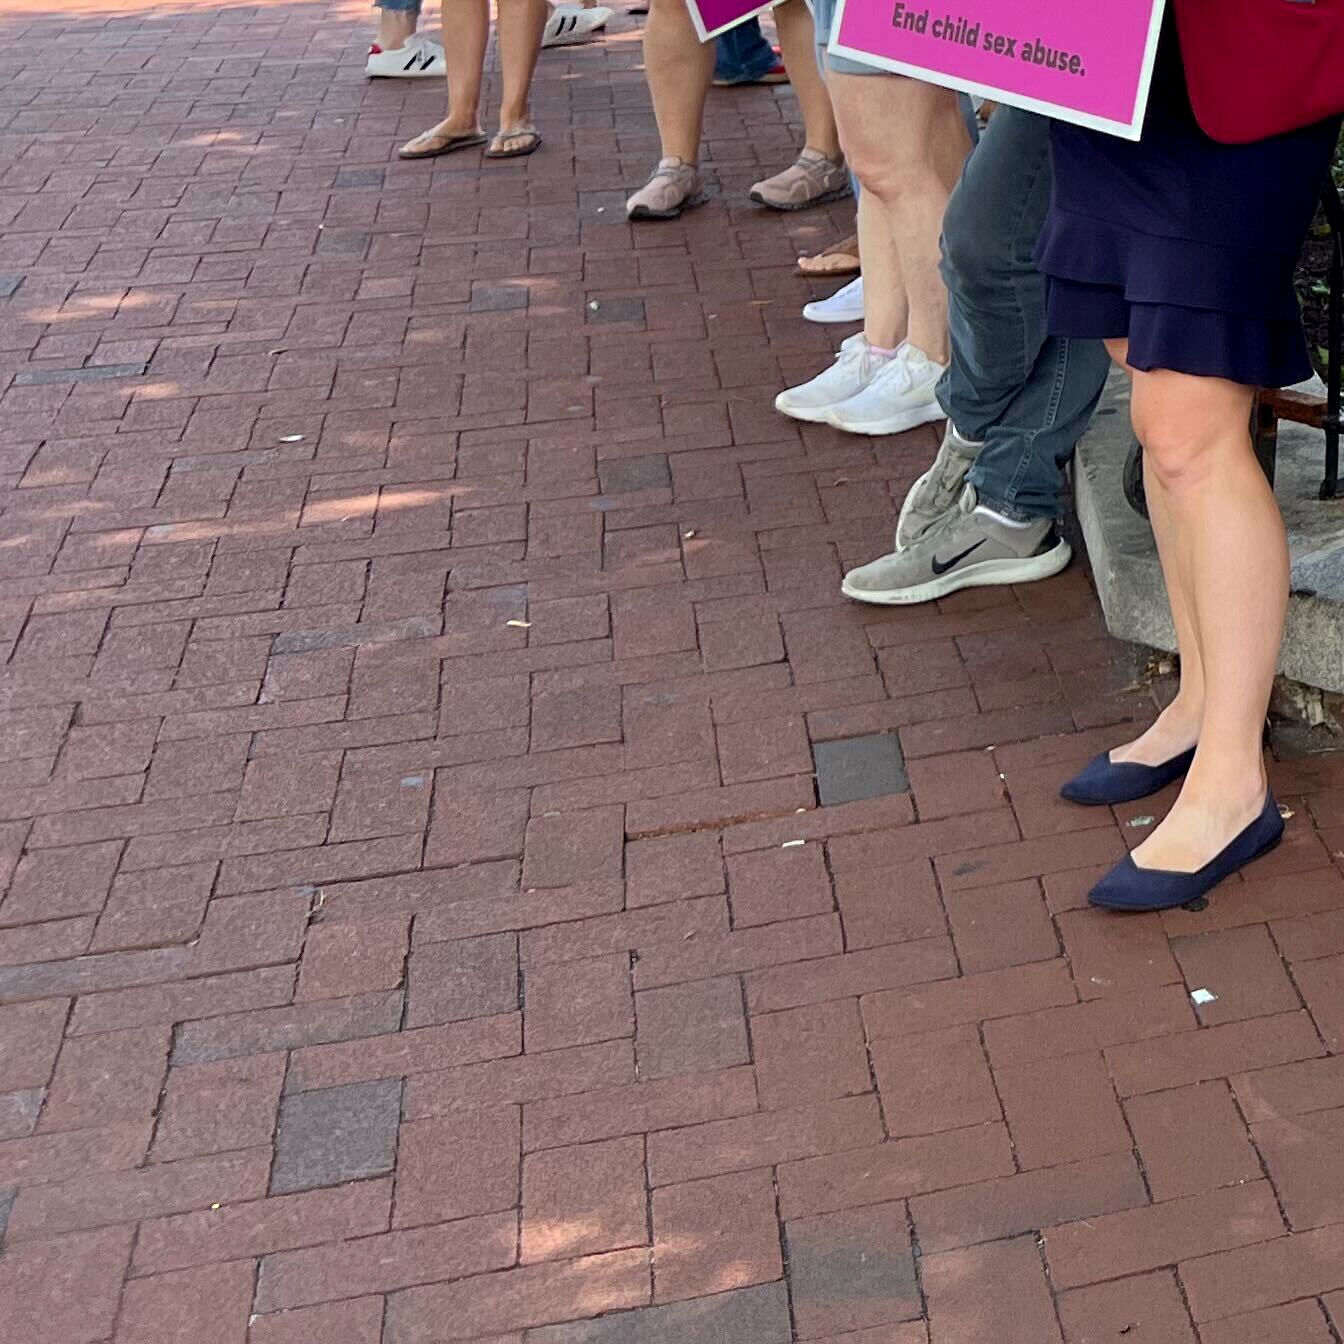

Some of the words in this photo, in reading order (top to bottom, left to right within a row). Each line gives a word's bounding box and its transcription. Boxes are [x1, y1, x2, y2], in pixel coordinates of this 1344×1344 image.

[891, 2, 929, 35] End
[932, 13, 981, 48] child
[983, 31, 1017, 58] sex
[1020, 39, 1087, 77] abuse.
